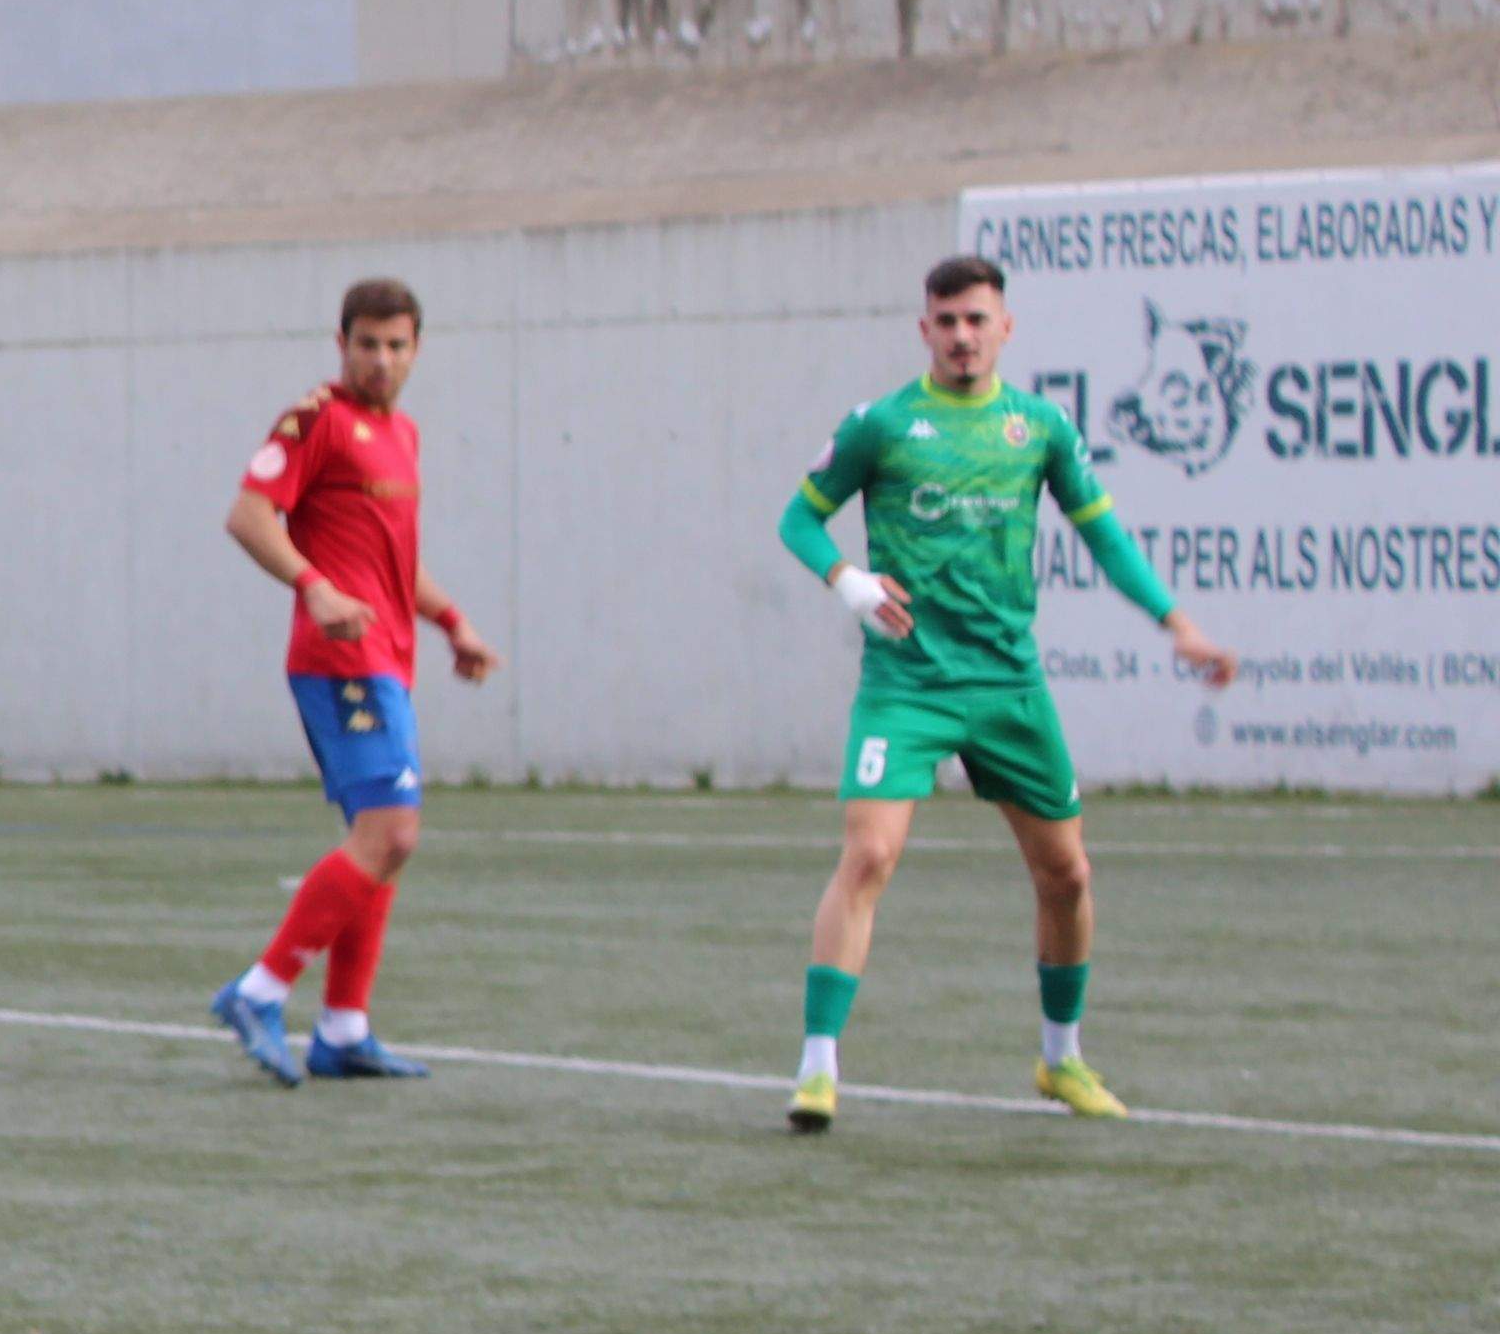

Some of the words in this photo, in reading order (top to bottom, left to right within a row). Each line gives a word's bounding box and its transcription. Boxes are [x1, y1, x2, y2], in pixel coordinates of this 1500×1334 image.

[976, 213, 1093, 269] CARNES
[1102, 204, 1247, 274] FRESCAS,
[1257, 194, 1470, 261] ELABORADAS
[1478, 193, 1500, 254] Y
[1171, 526, 1239, 590] PER
[1250, 525, 1318, 590] ALS
[1331, 524, 1500, 590] NOSTRES
